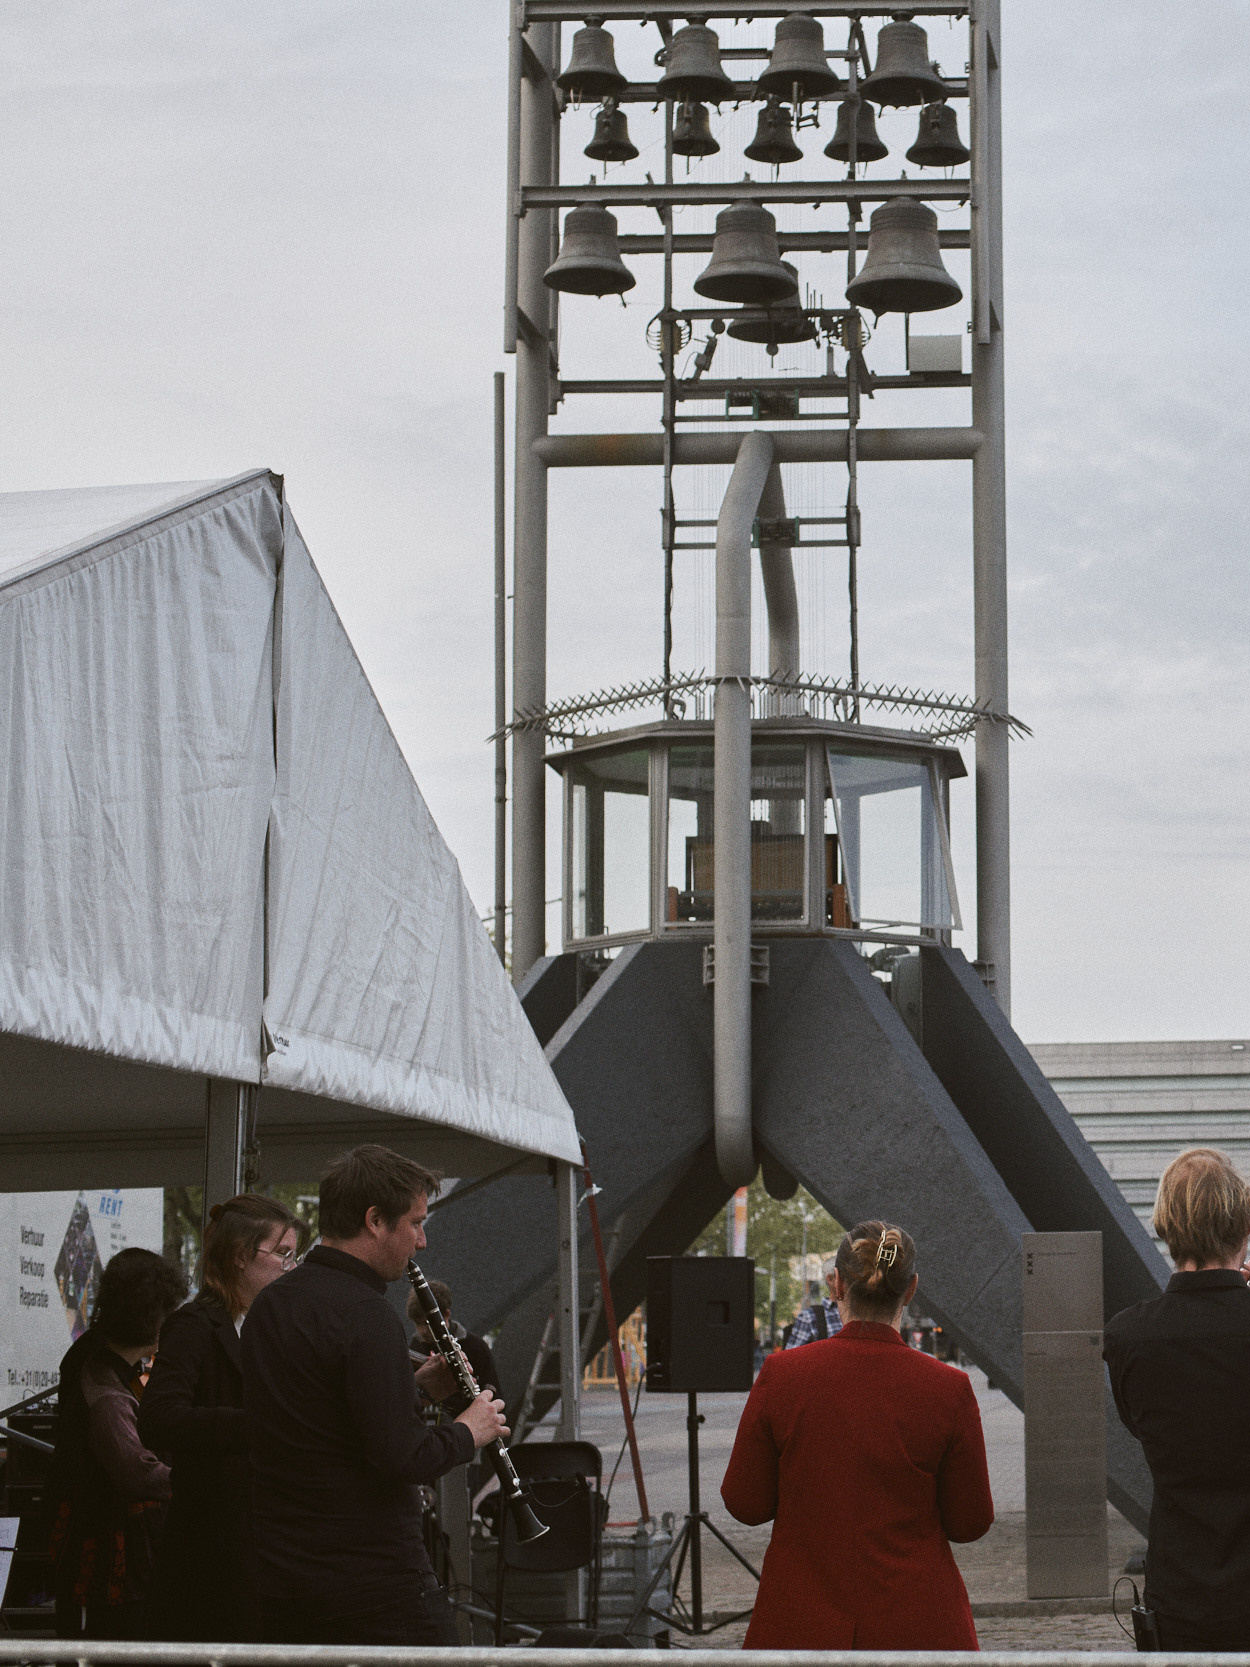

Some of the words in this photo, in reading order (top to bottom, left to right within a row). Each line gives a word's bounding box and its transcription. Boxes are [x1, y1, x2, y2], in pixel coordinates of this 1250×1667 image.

[21, 1225, 45, 1247] Verhuur
[20, 1255, 45, 1280] Verkoop
[20, 1286, 48, 1309] Reparatie
